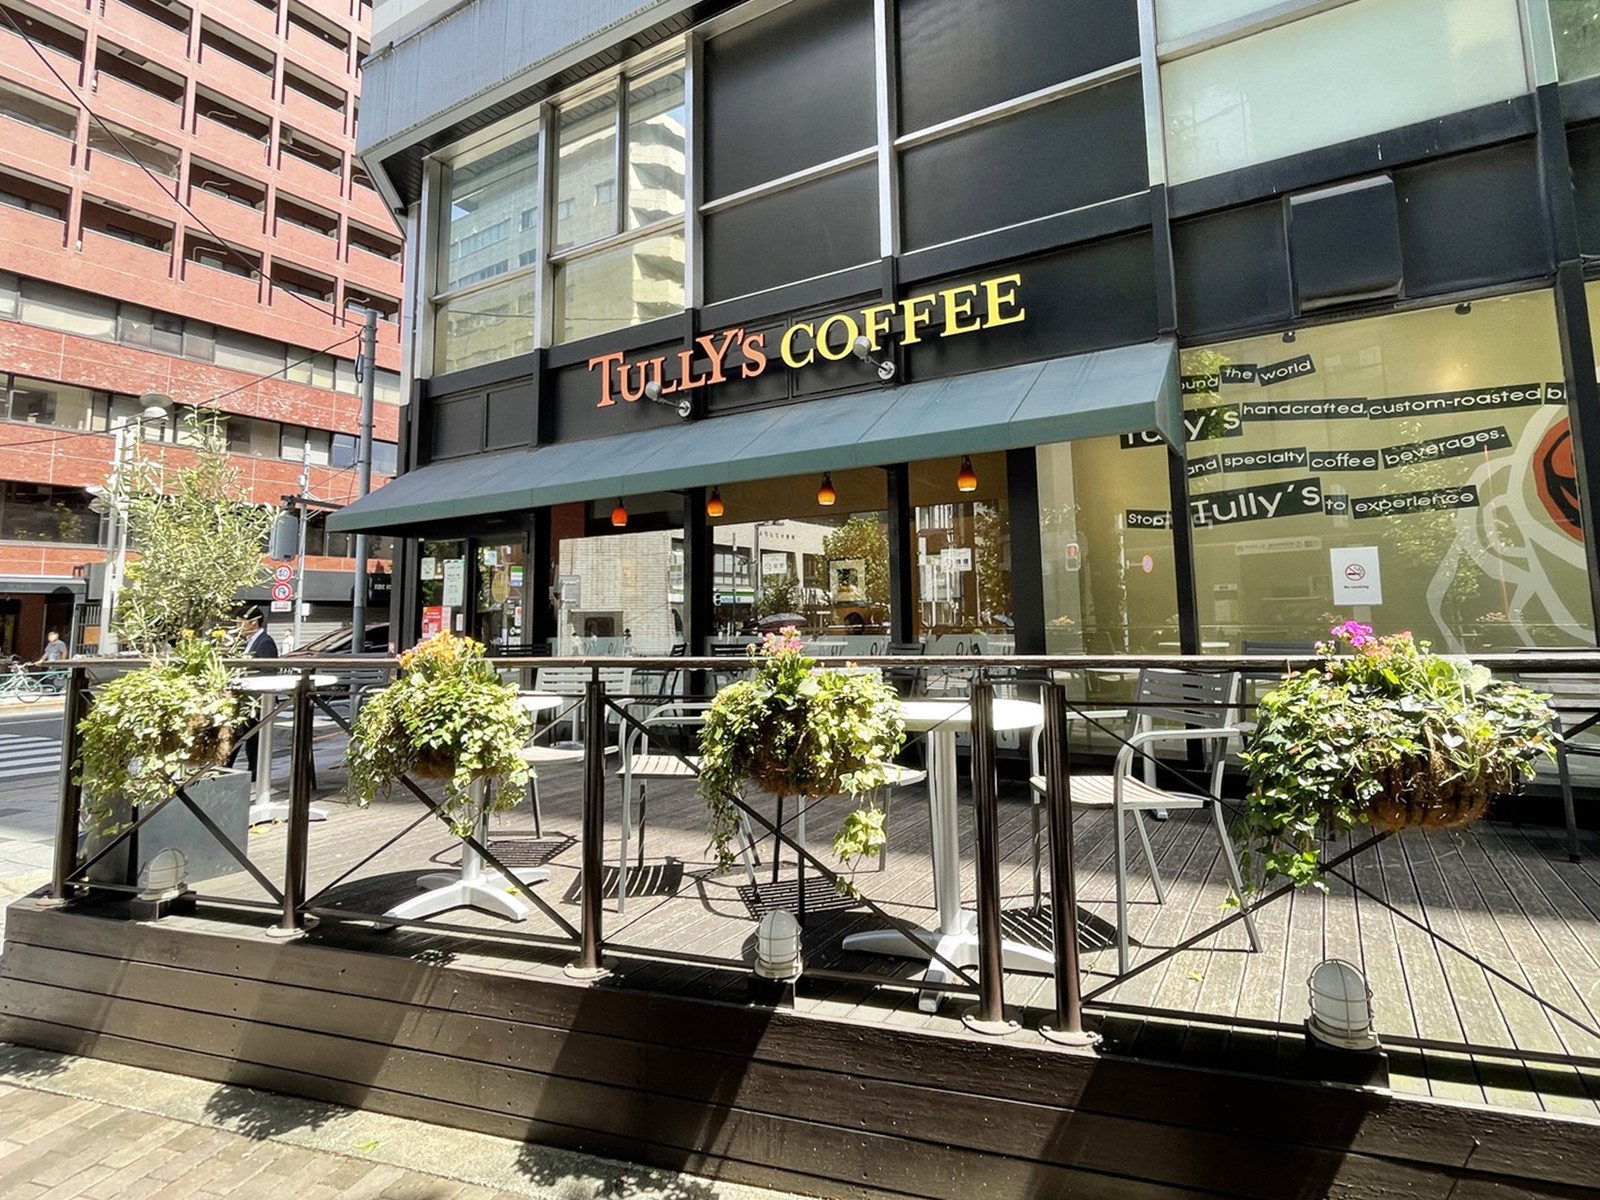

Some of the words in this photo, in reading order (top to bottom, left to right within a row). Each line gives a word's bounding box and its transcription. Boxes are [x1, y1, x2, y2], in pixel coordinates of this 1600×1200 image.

[780, 273, 1027, 369] COFFEE
[1225, 368, 1253, 380] the
[1260, 359, 1313, 382] world
[1369, 388, 1541, 416] custom-roasted
[1224, 451, 1306, 468] specialty
[1311, 453, 1376, 468] coffee
[1385, 429, 1506, 465] beverages.
[1128, 513, 1164, 527] Stop
[1190, 484, 1321, 525] Tully's
[1325, 499, 1347, 511] to
[1355, 492, 1475, 513] experience
